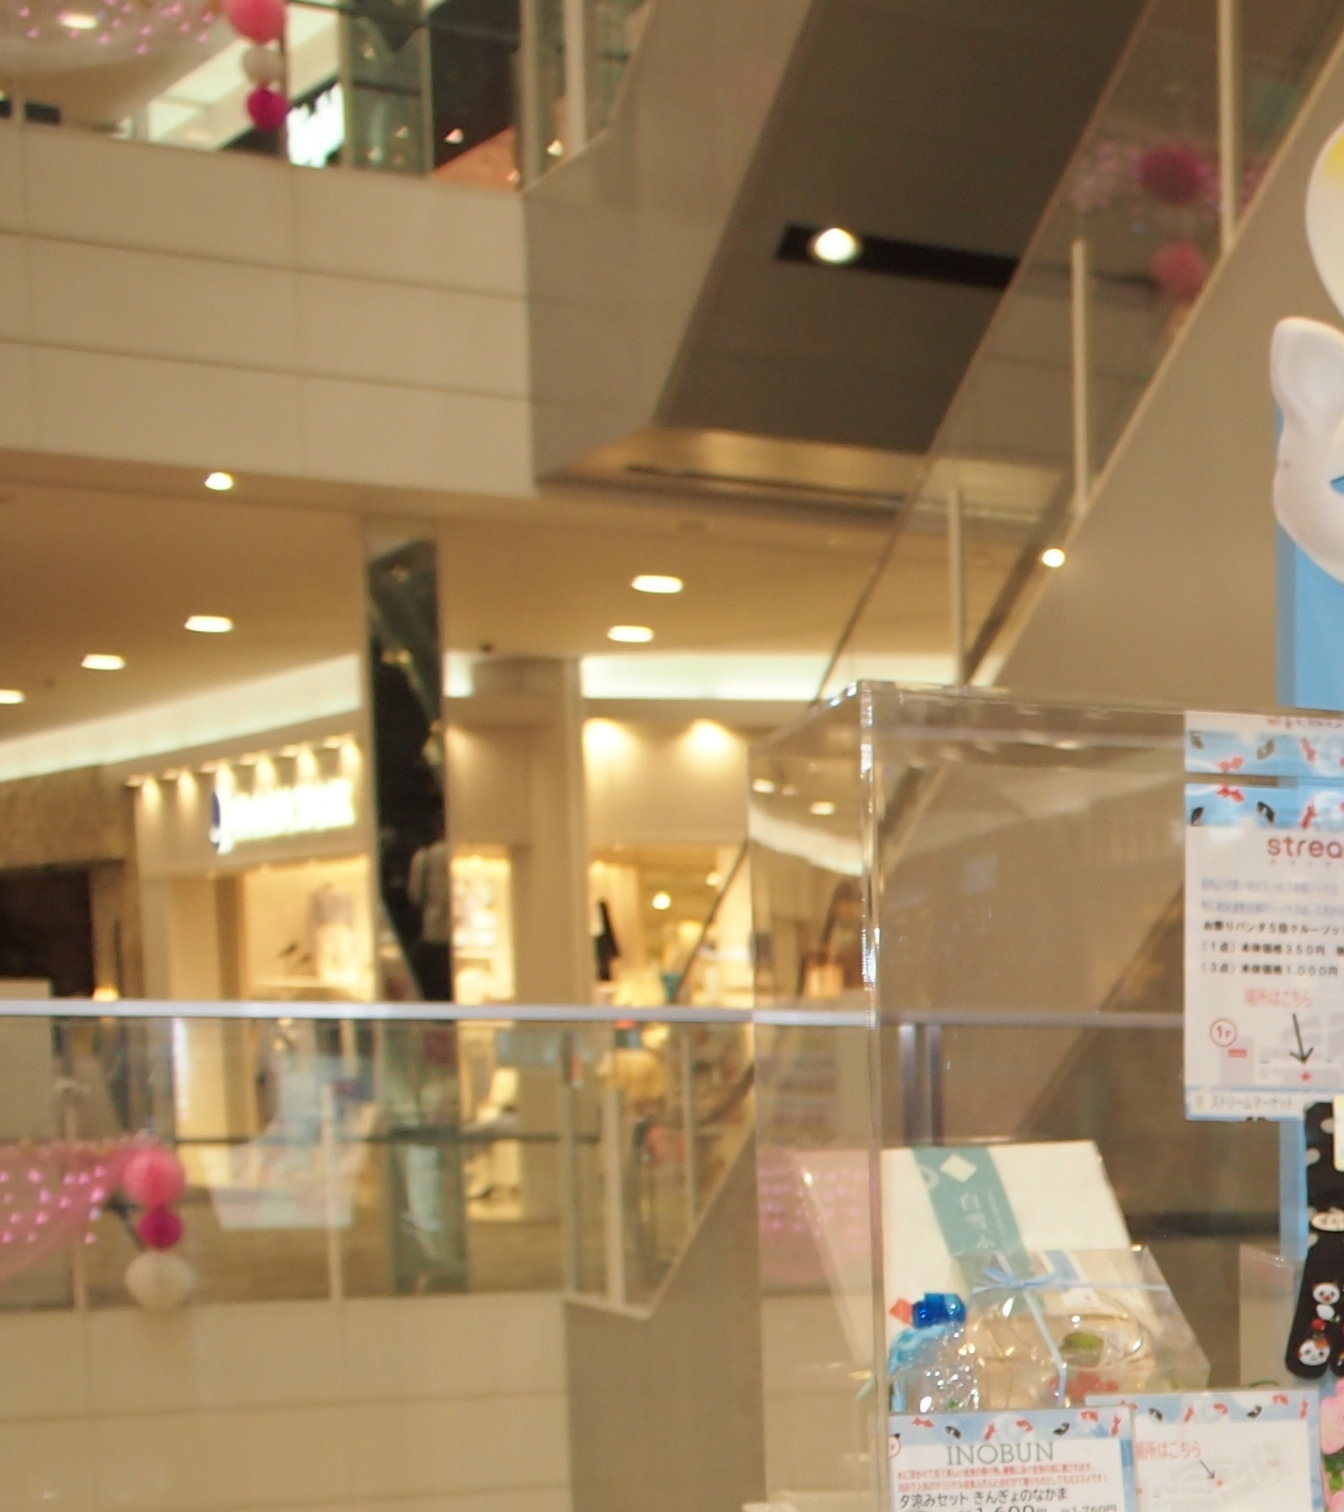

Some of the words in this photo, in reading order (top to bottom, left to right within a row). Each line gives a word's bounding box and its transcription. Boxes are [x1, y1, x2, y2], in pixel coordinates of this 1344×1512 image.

[946, 1442, 1054, 1466] INOBUN
[973, 1487, 1068, 1506] きんぎょのなかま
